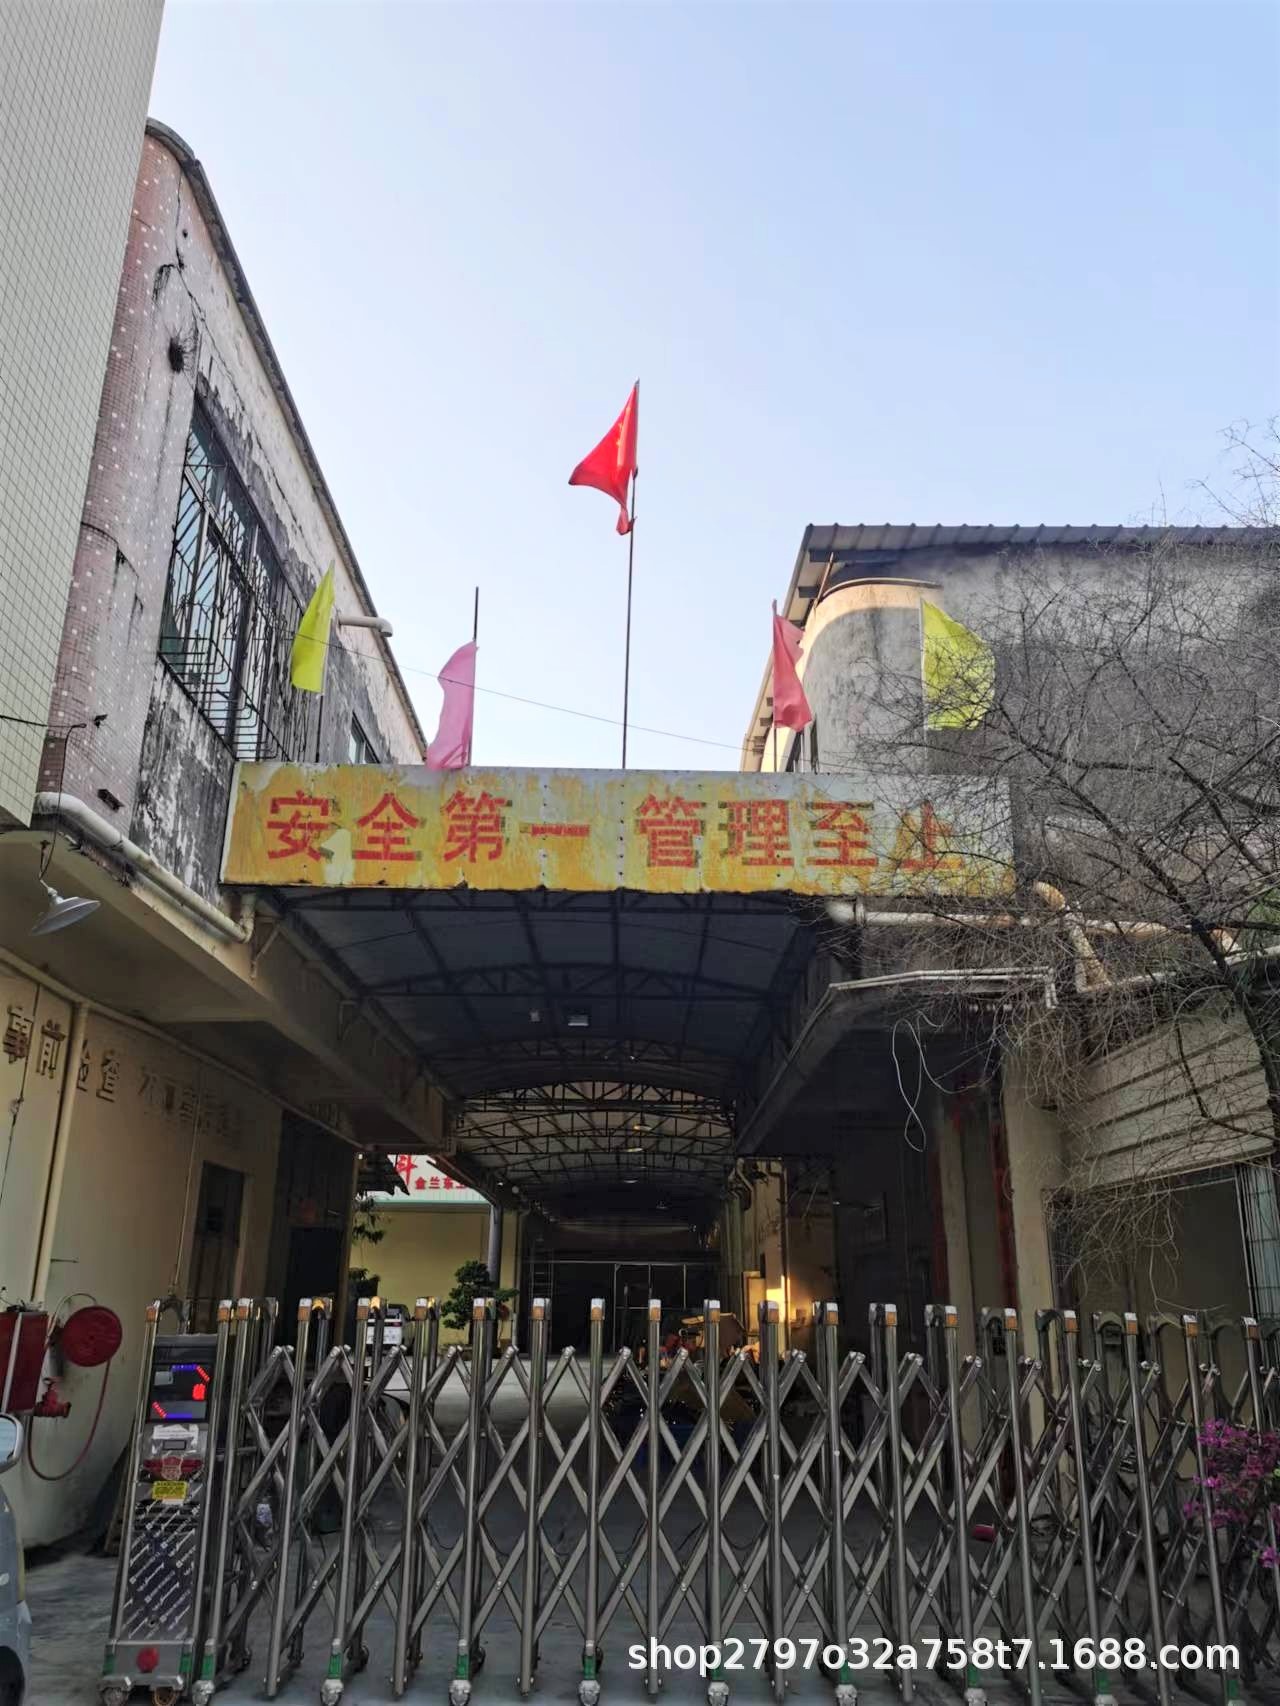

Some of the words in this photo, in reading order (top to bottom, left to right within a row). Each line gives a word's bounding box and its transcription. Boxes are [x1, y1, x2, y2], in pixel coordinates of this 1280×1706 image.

[267, 790, 591, 863] 安全第一
[635, 794, 964, 869] 管理至上
